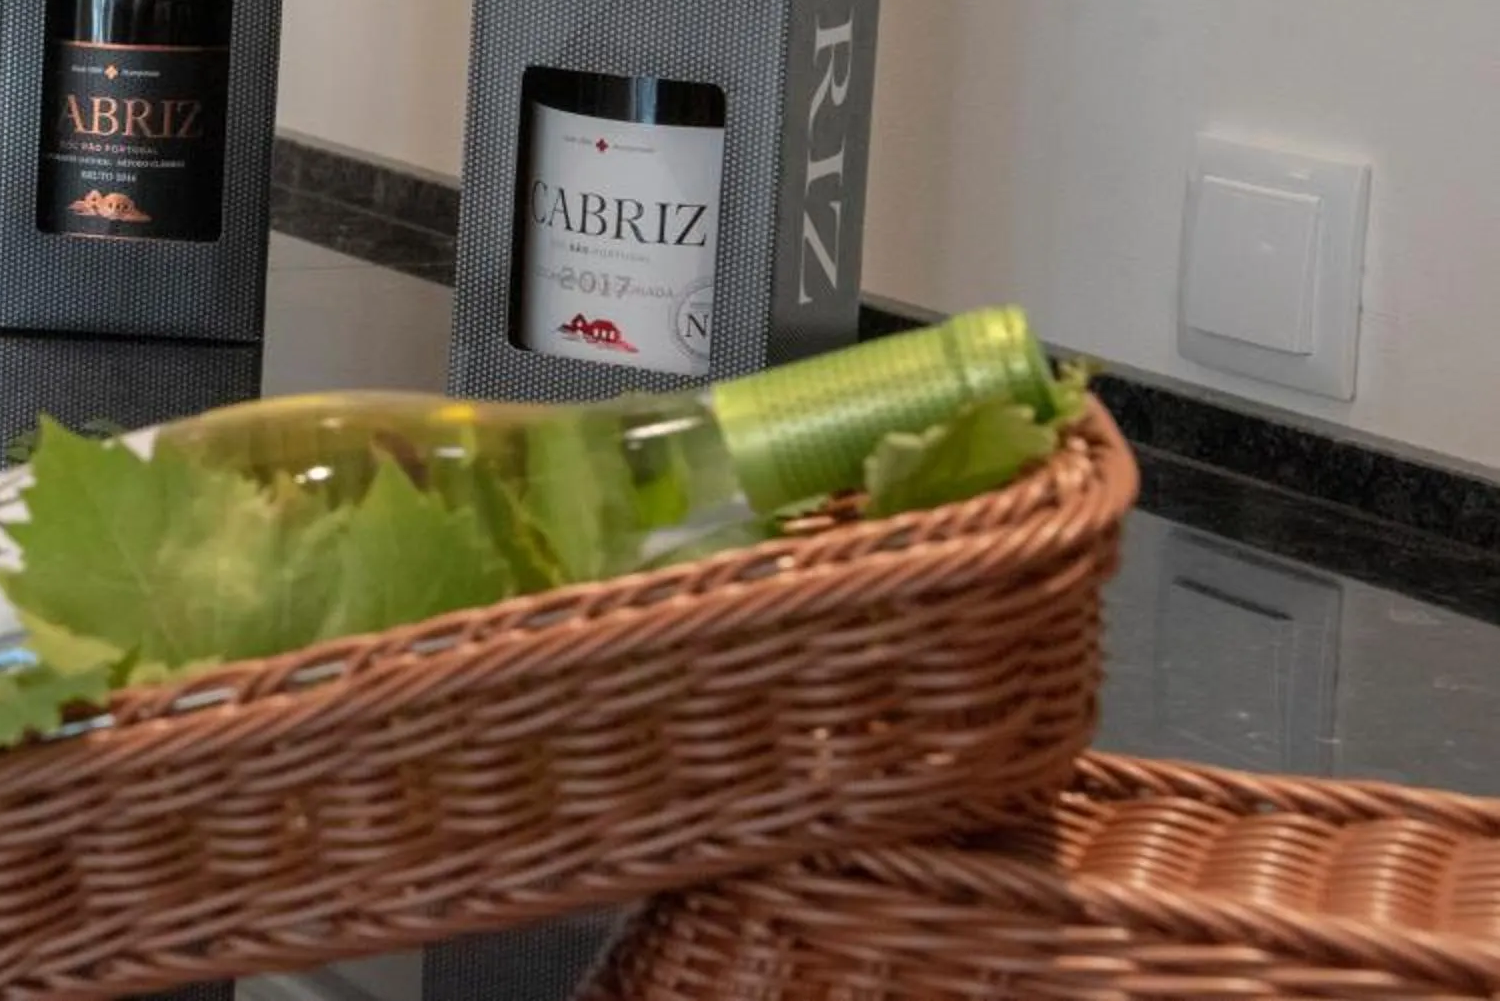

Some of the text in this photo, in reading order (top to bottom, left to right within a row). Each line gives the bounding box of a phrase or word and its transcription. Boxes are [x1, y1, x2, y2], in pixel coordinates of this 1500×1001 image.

[55, 94, 205, 139] ABRIZ
[532, 180, 708, 247] CABRIZ
[559, 266, 634, 299] 2017
